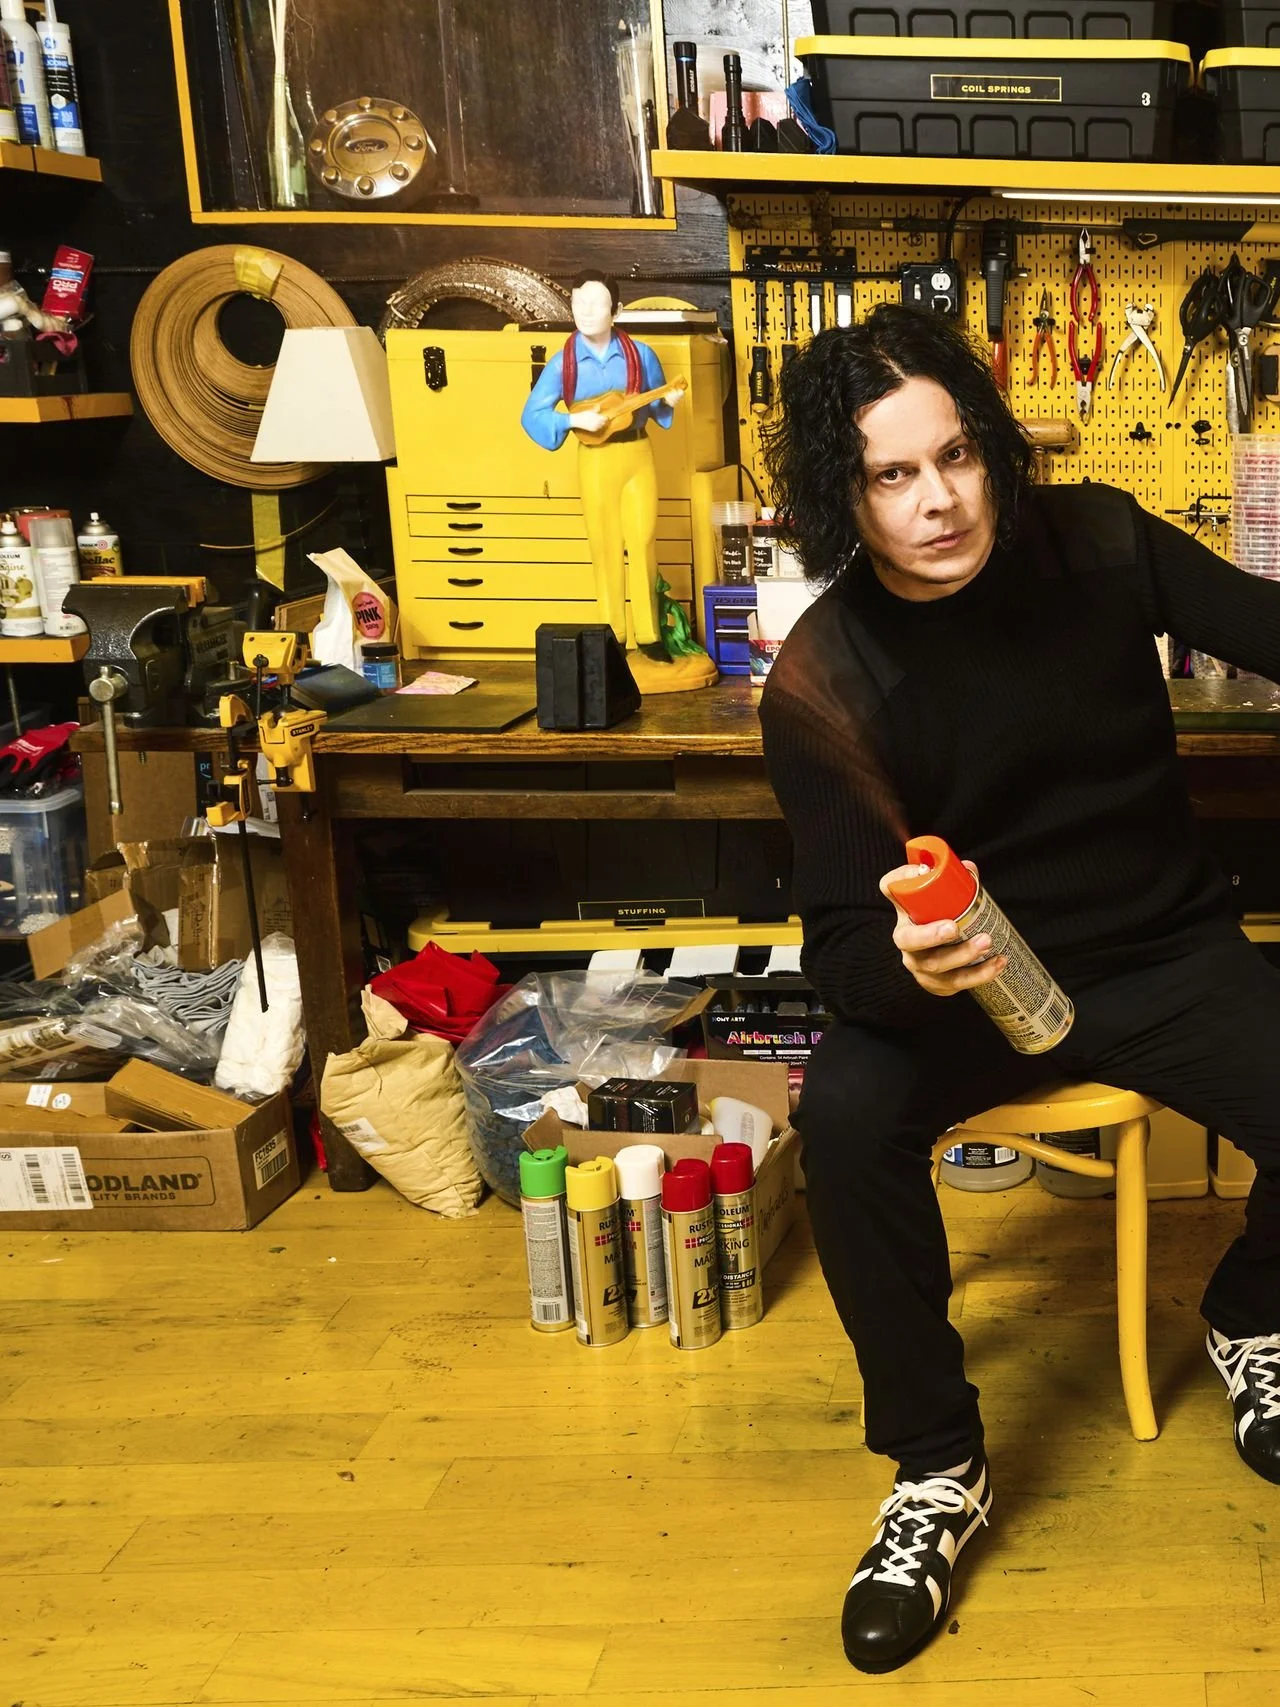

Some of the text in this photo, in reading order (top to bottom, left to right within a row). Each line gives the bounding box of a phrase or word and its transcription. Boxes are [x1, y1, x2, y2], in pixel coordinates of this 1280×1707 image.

[961, 85, 1031, 94] COIL SPRINGS
[1141, 91, 1151, 106] 3
[777, 261, 822, 272] DEWALT
[354, 606, 382, 625] PINK
[776, 877, 783, 889] 1
[1232, 875, 1240, 886] 3
[727, 1031, 806, 1045] Airbrush
[88, 1173, 199, 1192] ODLAND
[94, 1192, 176, 1201] LITY BRANDS
[719, 1205, 749, 1216] OLEUM
